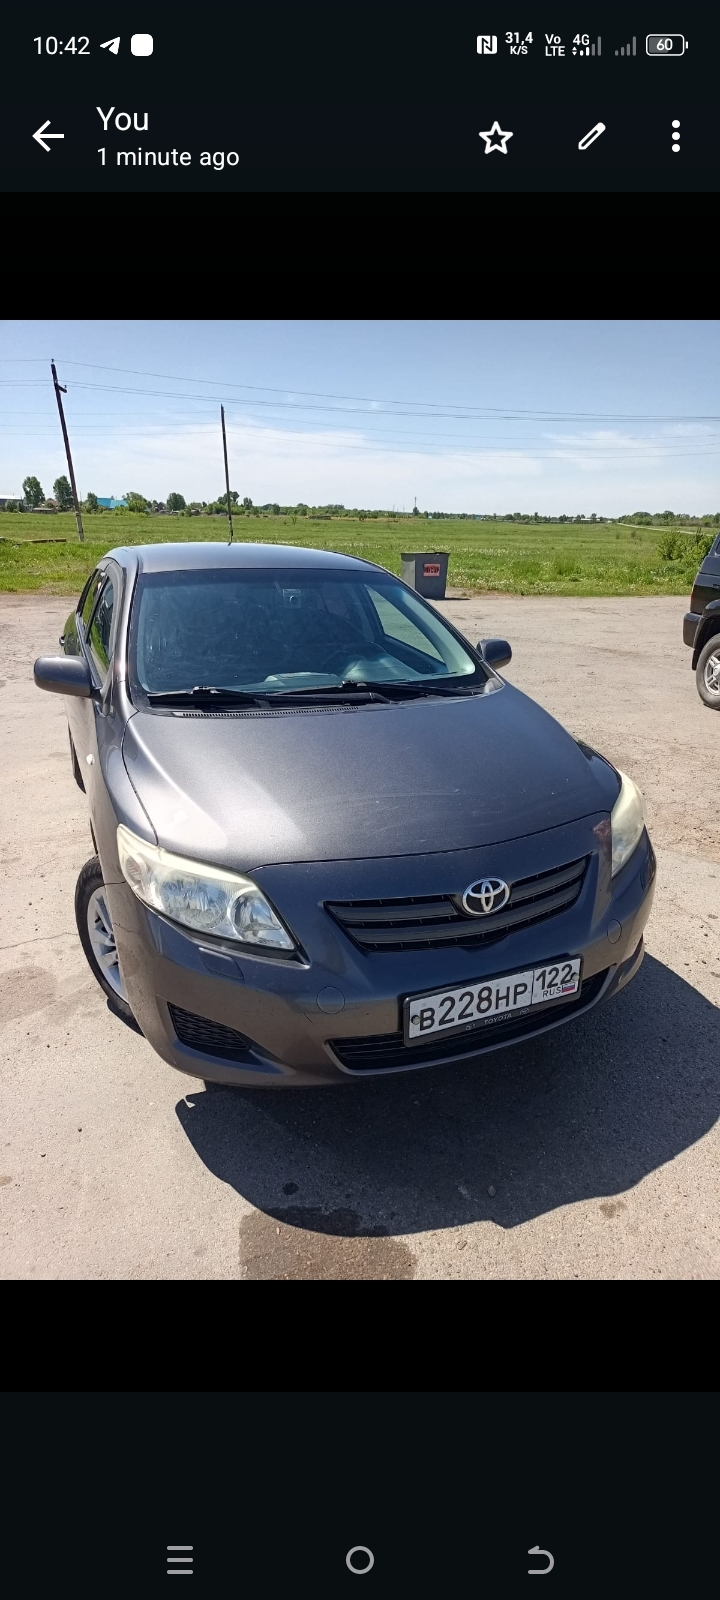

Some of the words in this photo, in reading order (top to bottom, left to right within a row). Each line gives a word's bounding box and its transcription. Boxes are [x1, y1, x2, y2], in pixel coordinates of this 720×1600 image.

[535, 963, 573, 990] 122
[542, 986, 562, 998] RUS
[483, 1013, 512, 1025] TOYOTA
